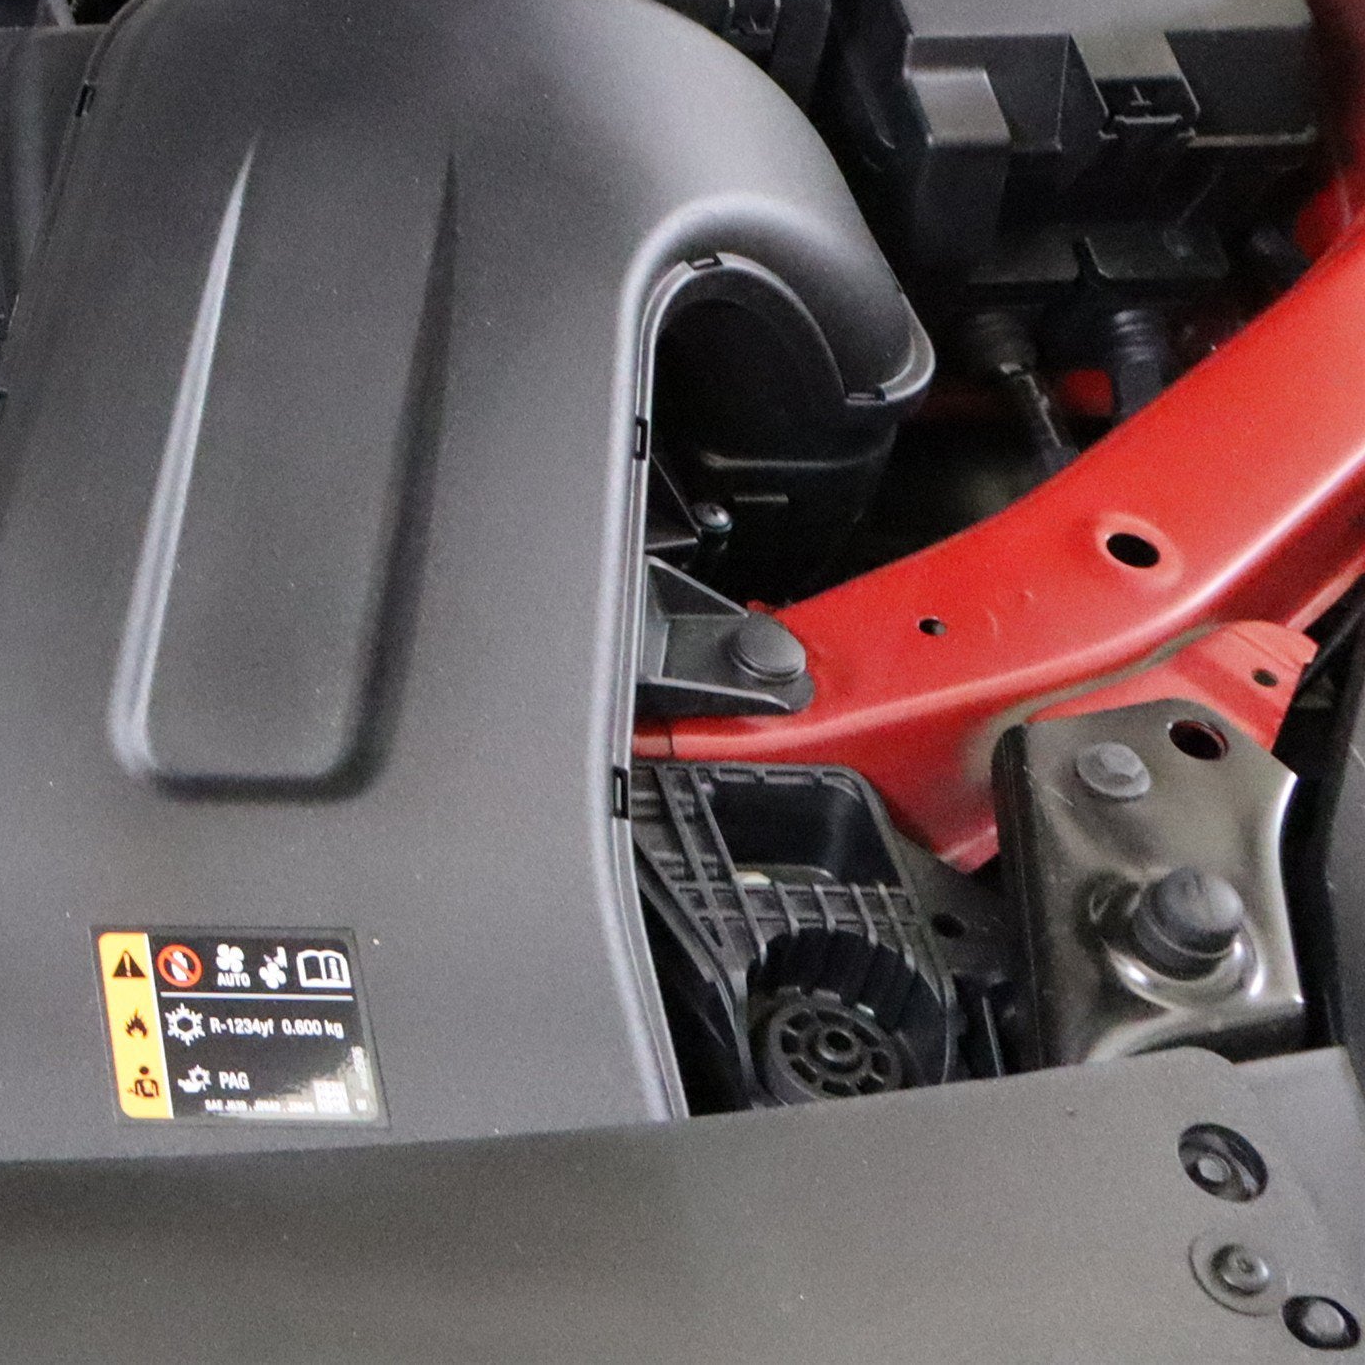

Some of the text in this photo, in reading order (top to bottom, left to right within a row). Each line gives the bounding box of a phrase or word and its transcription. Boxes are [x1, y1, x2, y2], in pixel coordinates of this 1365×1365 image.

[217, 972, 251, 987] AUTO
[209, 1017, 345, 1039] R-1234yf 0.600 kg
[219, 1071, 250, 1091] PAG
